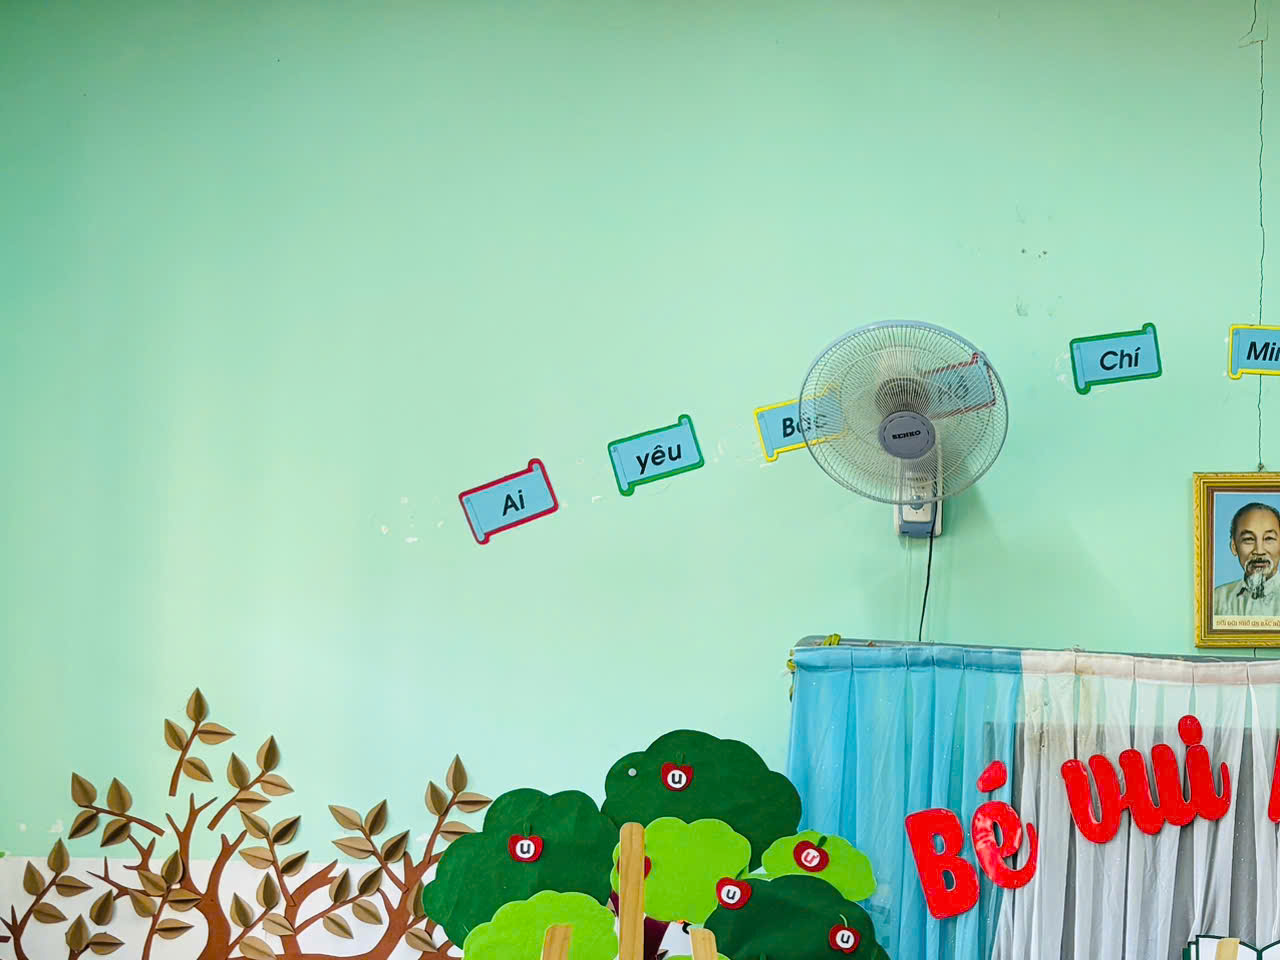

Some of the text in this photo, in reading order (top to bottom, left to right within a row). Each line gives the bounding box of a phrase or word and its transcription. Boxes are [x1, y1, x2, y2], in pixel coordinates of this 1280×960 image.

[502, 489, 525, 516] Ai
[636, 444, 682, 475] yêu
[1100, 347, 1141, 370] Chí
[671, 772, 683, 785] u
[905, 760, 1038, 920] Bé
[1061, 715, 1229, 844] vui
[519, 843, 531, 855] u
[725, 888, 737, 901] u
[840, 933, 851, 945] u
